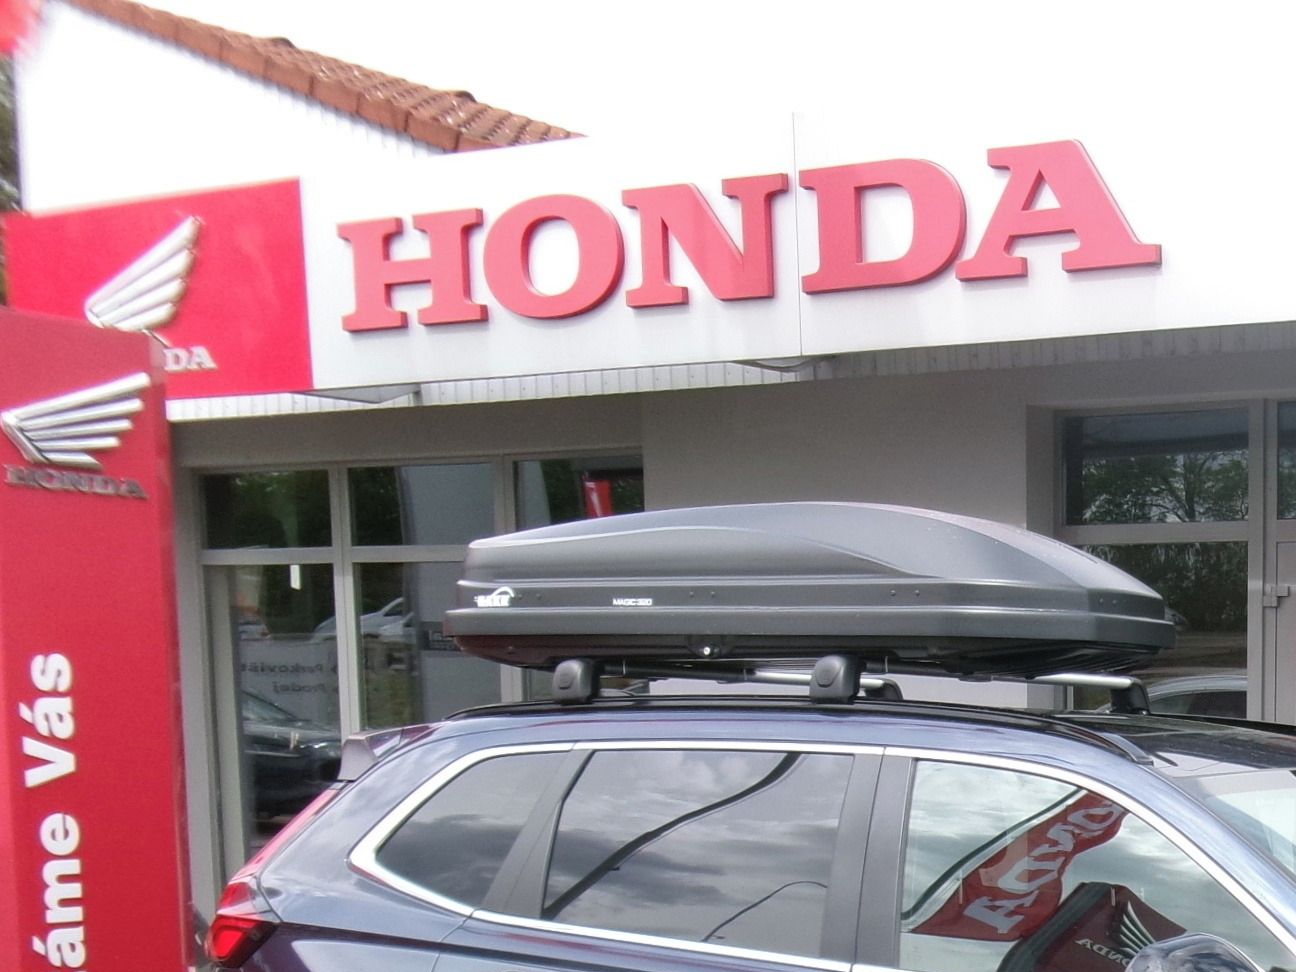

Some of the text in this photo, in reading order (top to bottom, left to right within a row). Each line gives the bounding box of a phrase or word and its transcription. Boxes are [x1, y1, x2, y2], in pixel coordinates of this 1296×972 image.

[337, 138, 1163, 333] HONDA
[3, 463, 149, 501] HONDA
[19, 652, 76, 788] Vás
